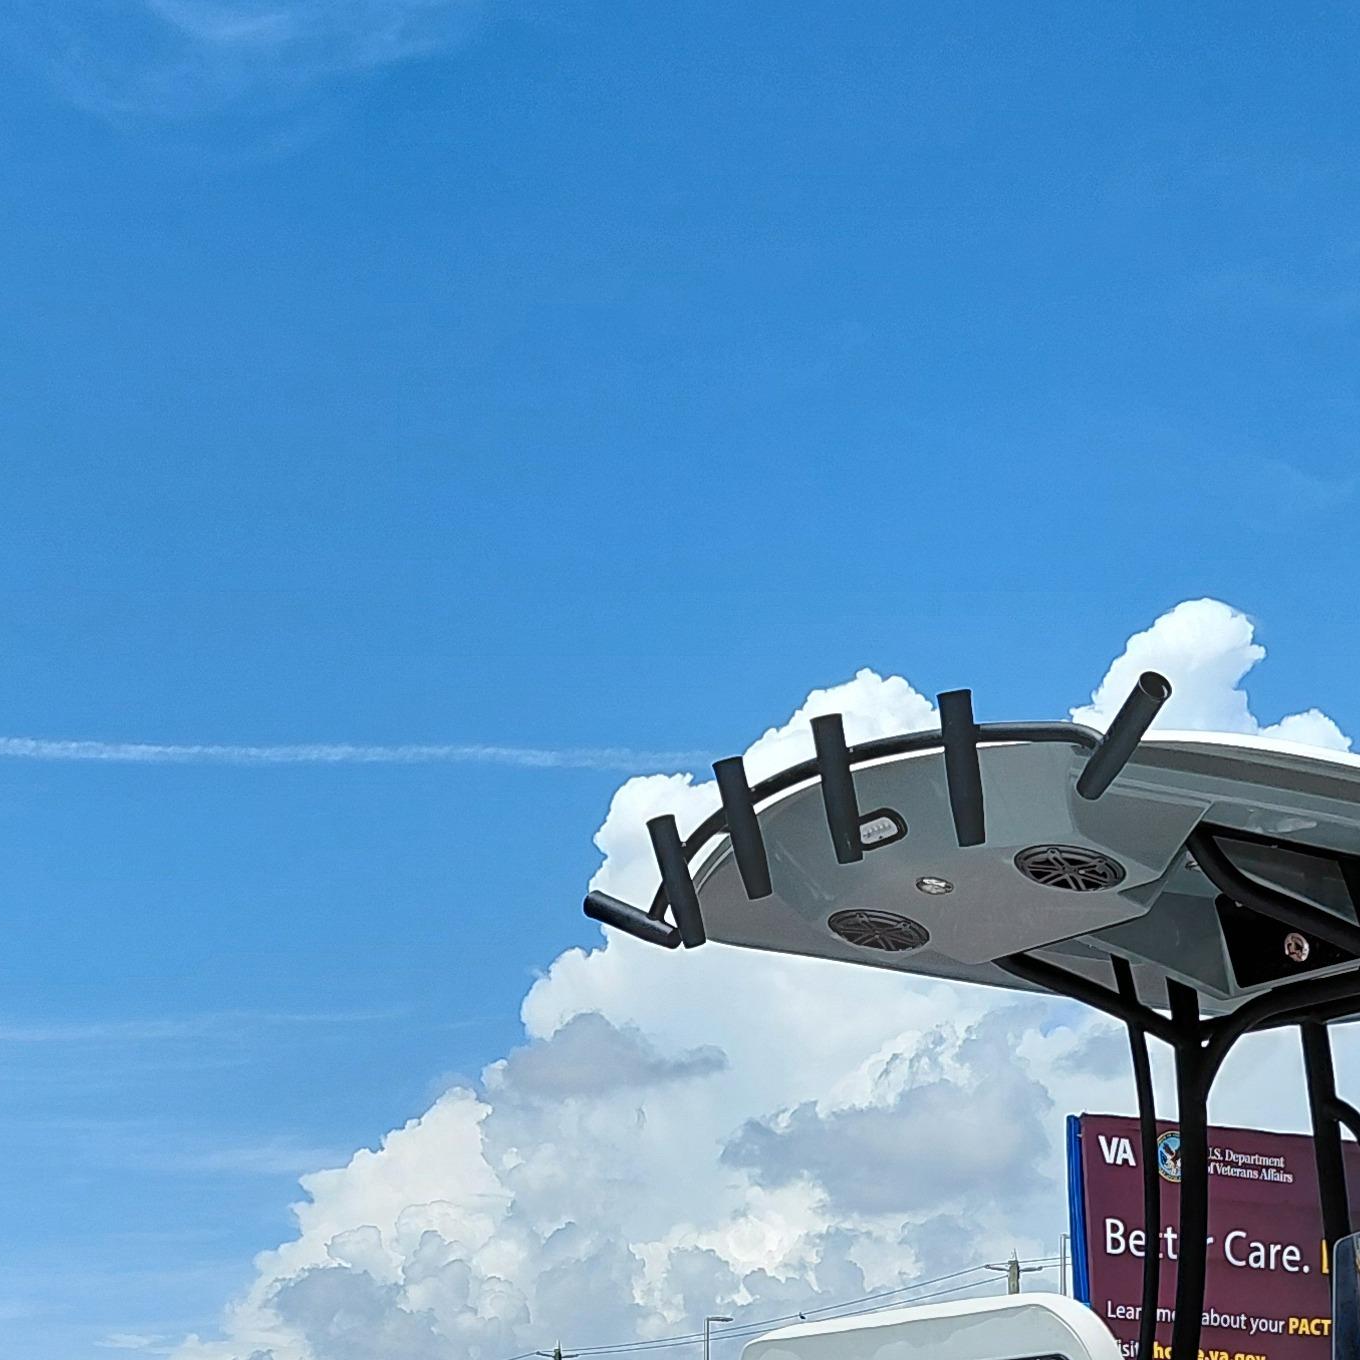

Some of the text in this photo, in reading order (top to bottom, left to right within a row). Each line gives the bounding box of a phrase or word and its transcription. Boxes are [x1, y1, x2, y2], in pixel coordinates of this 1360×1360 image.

[1098, 1134, 1136, 1167] VA
[1225, 1149, 1284, 1167] Department
[1215, 1163, 1259, 1180] Veterans
[1259, 1170, 1294, 1184] Affairs
[1224, 1230, 1310, 1274] Care.
[1107, 1300, 1143, 1321] Lear
[1201, 1307, 1247, 1330] about
[1250, 1315, 1285, 1335] your
[1288, 1317, 1332, 1336] PACT
